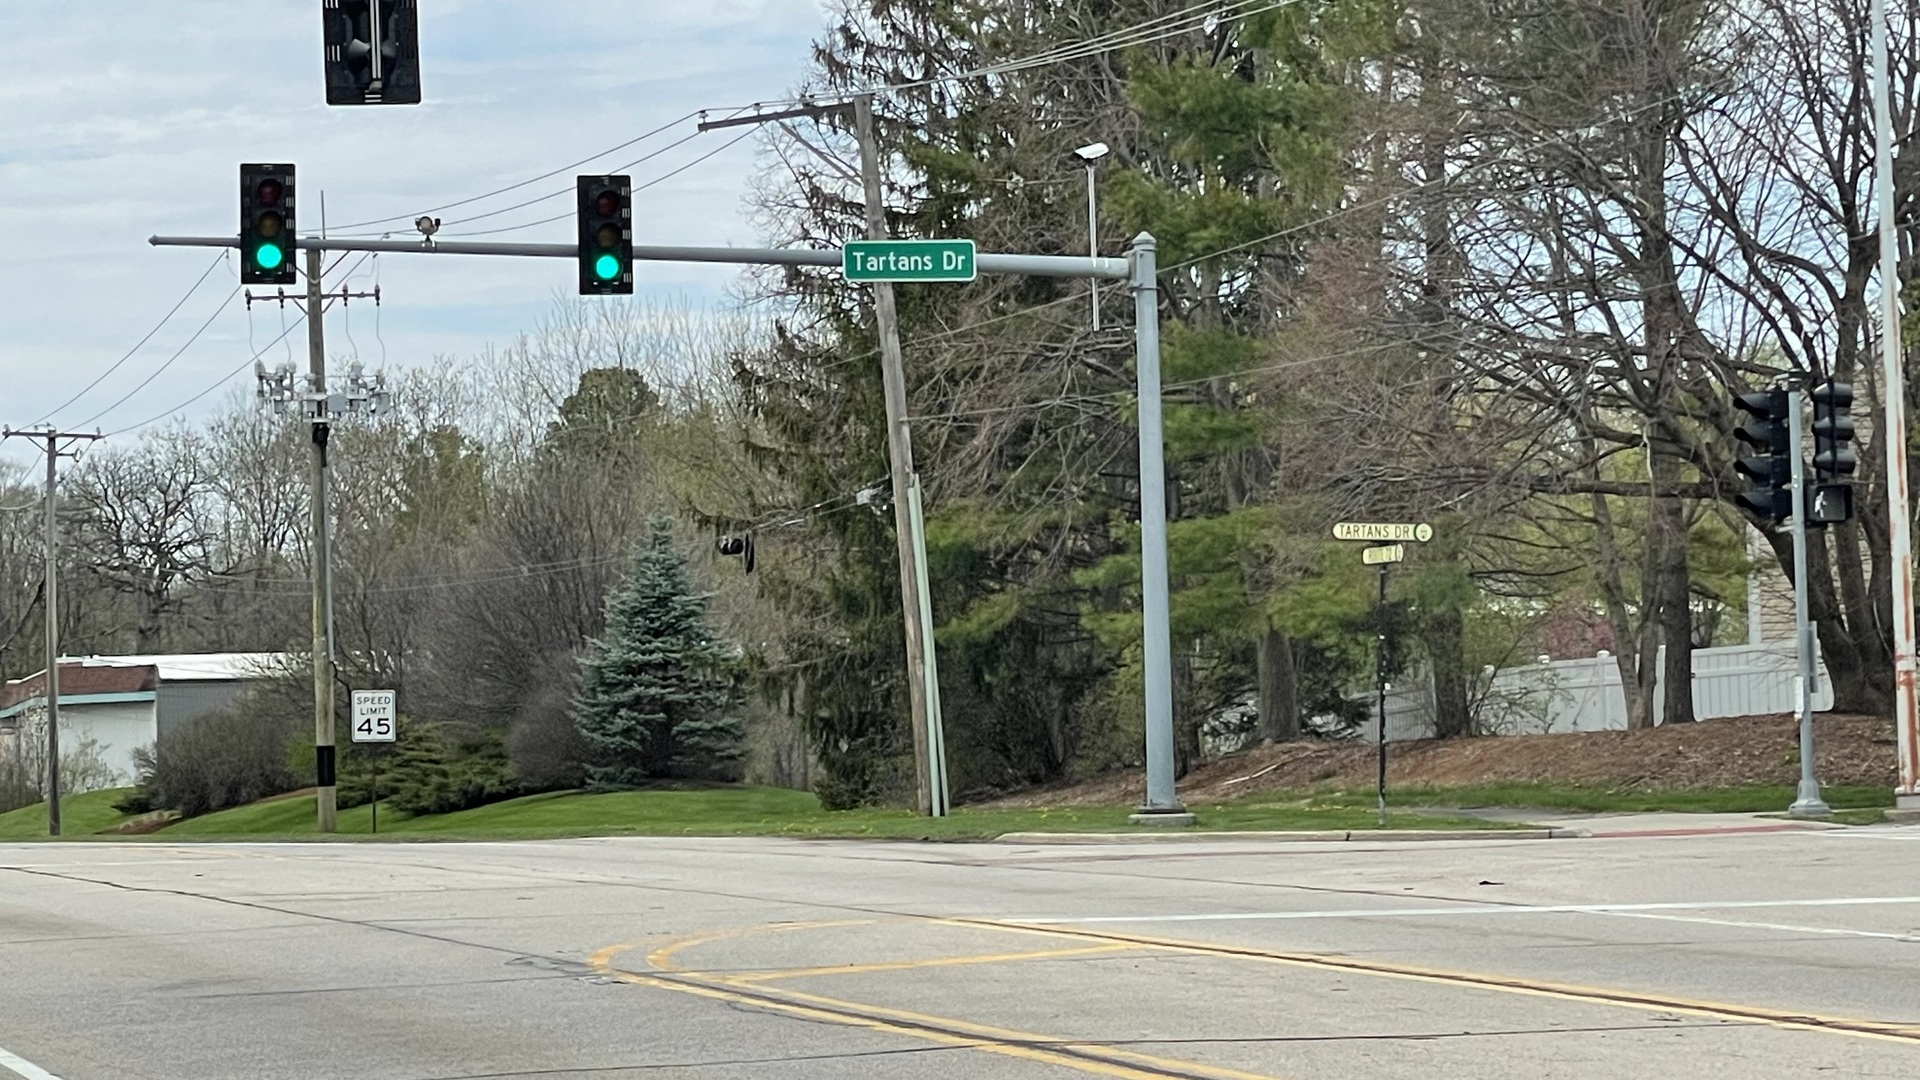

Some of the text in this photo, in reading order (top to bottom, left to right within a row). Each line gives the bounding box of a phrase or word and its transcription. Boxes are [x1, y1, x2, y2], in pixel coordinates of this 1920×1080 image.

[853, 251, 966, 271] Tartans Dr
[1340, 525, 1411, 538] TARTANS DR
[356, 696, 391, 705] SPEED
[360, 707, 387, 715] LIMIT
[357, 718, 391, 735] 45
